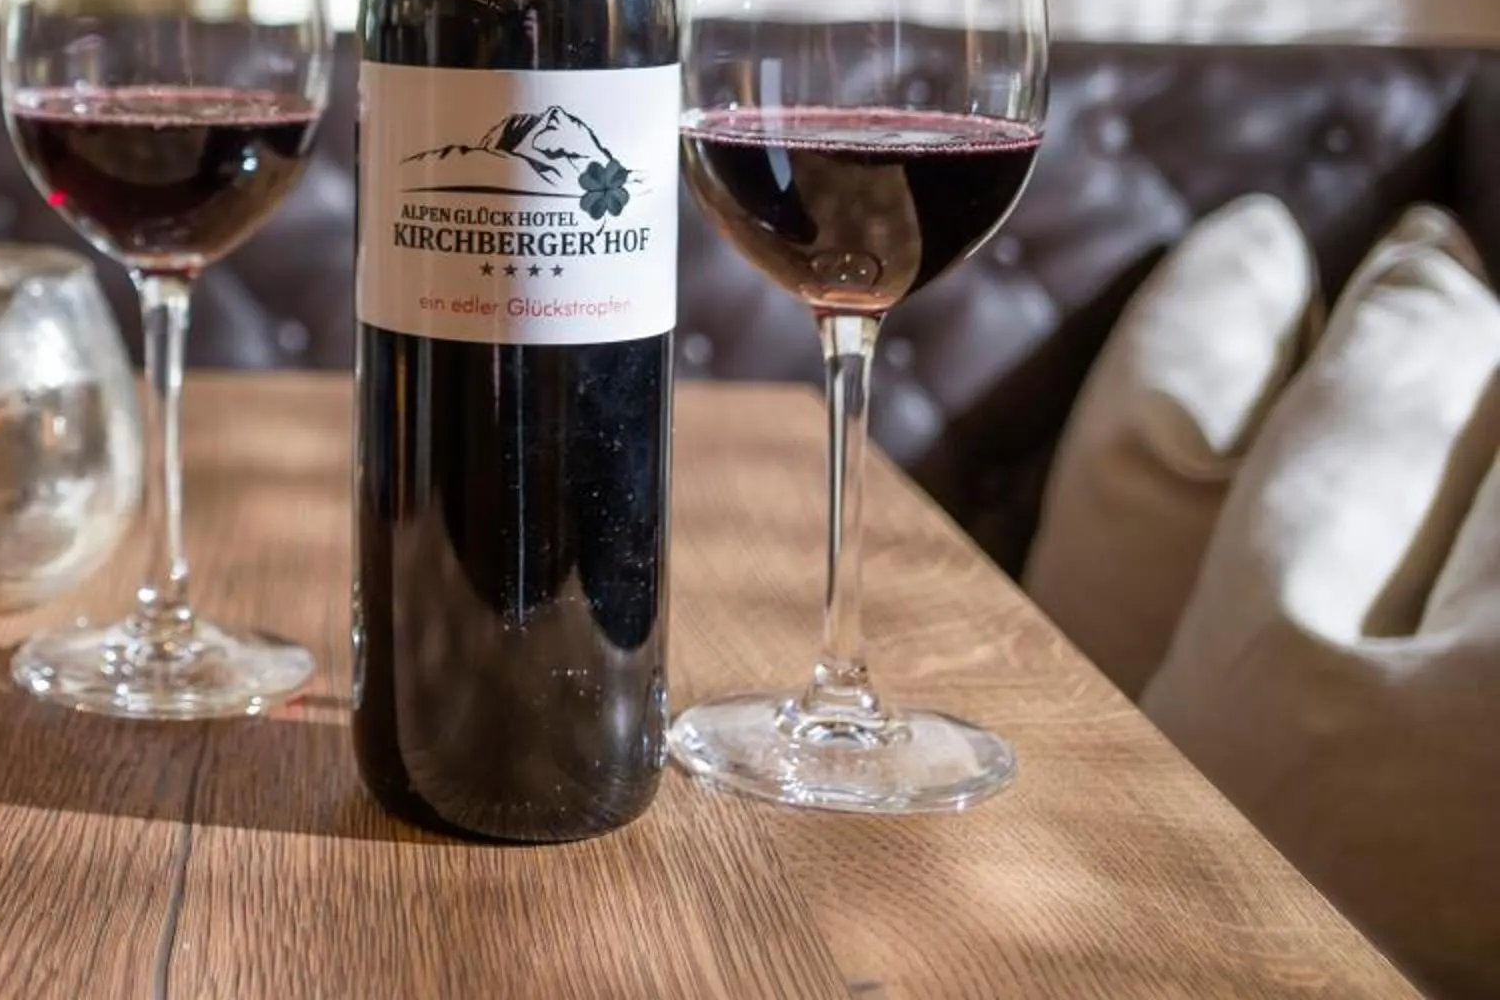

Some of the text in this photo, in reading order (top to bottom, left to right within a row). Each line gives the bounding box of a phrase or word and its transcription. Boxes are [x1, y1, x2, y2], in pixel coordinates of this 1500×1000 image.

[402, 204, 579, 227] ALPEN GLÜCK HOTEL
[393, 223, 650, 257] KIRCHBERGER HOF
[419, 293, 631, 319] ein edler Glückstropfen
